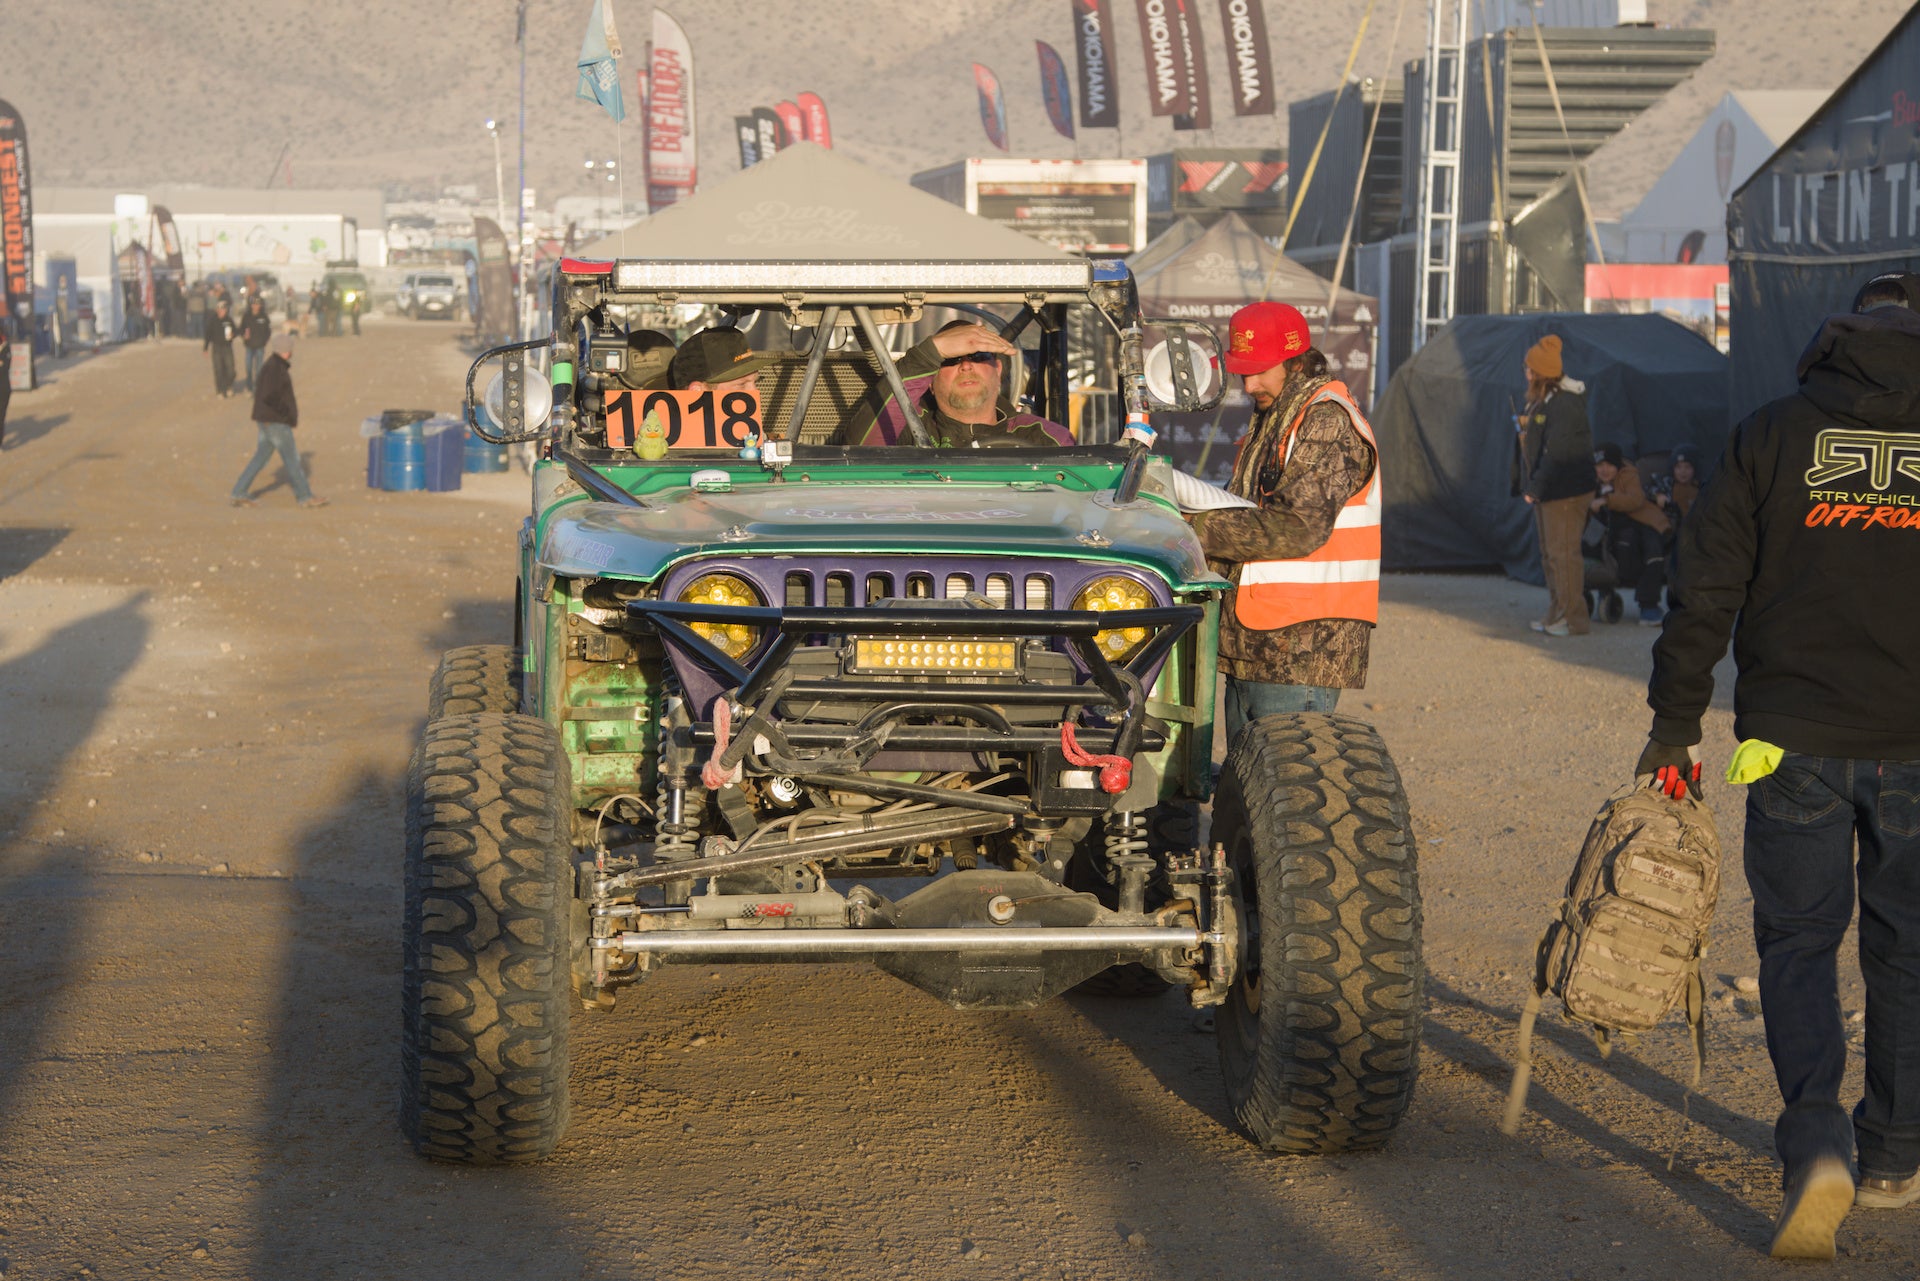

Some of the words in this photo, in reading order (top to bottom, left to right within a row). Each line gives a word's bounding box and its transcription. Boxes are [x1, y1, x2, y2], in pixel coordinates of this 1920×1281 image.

[1082, 11, 1106, 118] YOKOHAMA
[0, 139, 26, 294] STRONGEST
[1772, 173, 1825, 244] LIT
[1837, 168, 1872, 243] IN
[1168, 304, 1211, 318] DANG
[606, 390, 761, 447] 1018
[1809, 490, 1849, 503] RTR
[1853, 492, 1920, 507] VEHICL
[1804, 502, 1920, 531] OFF-ROA
[1652, 863, 1676, 881] Wick
[755, 902, 795, 917] PSC
